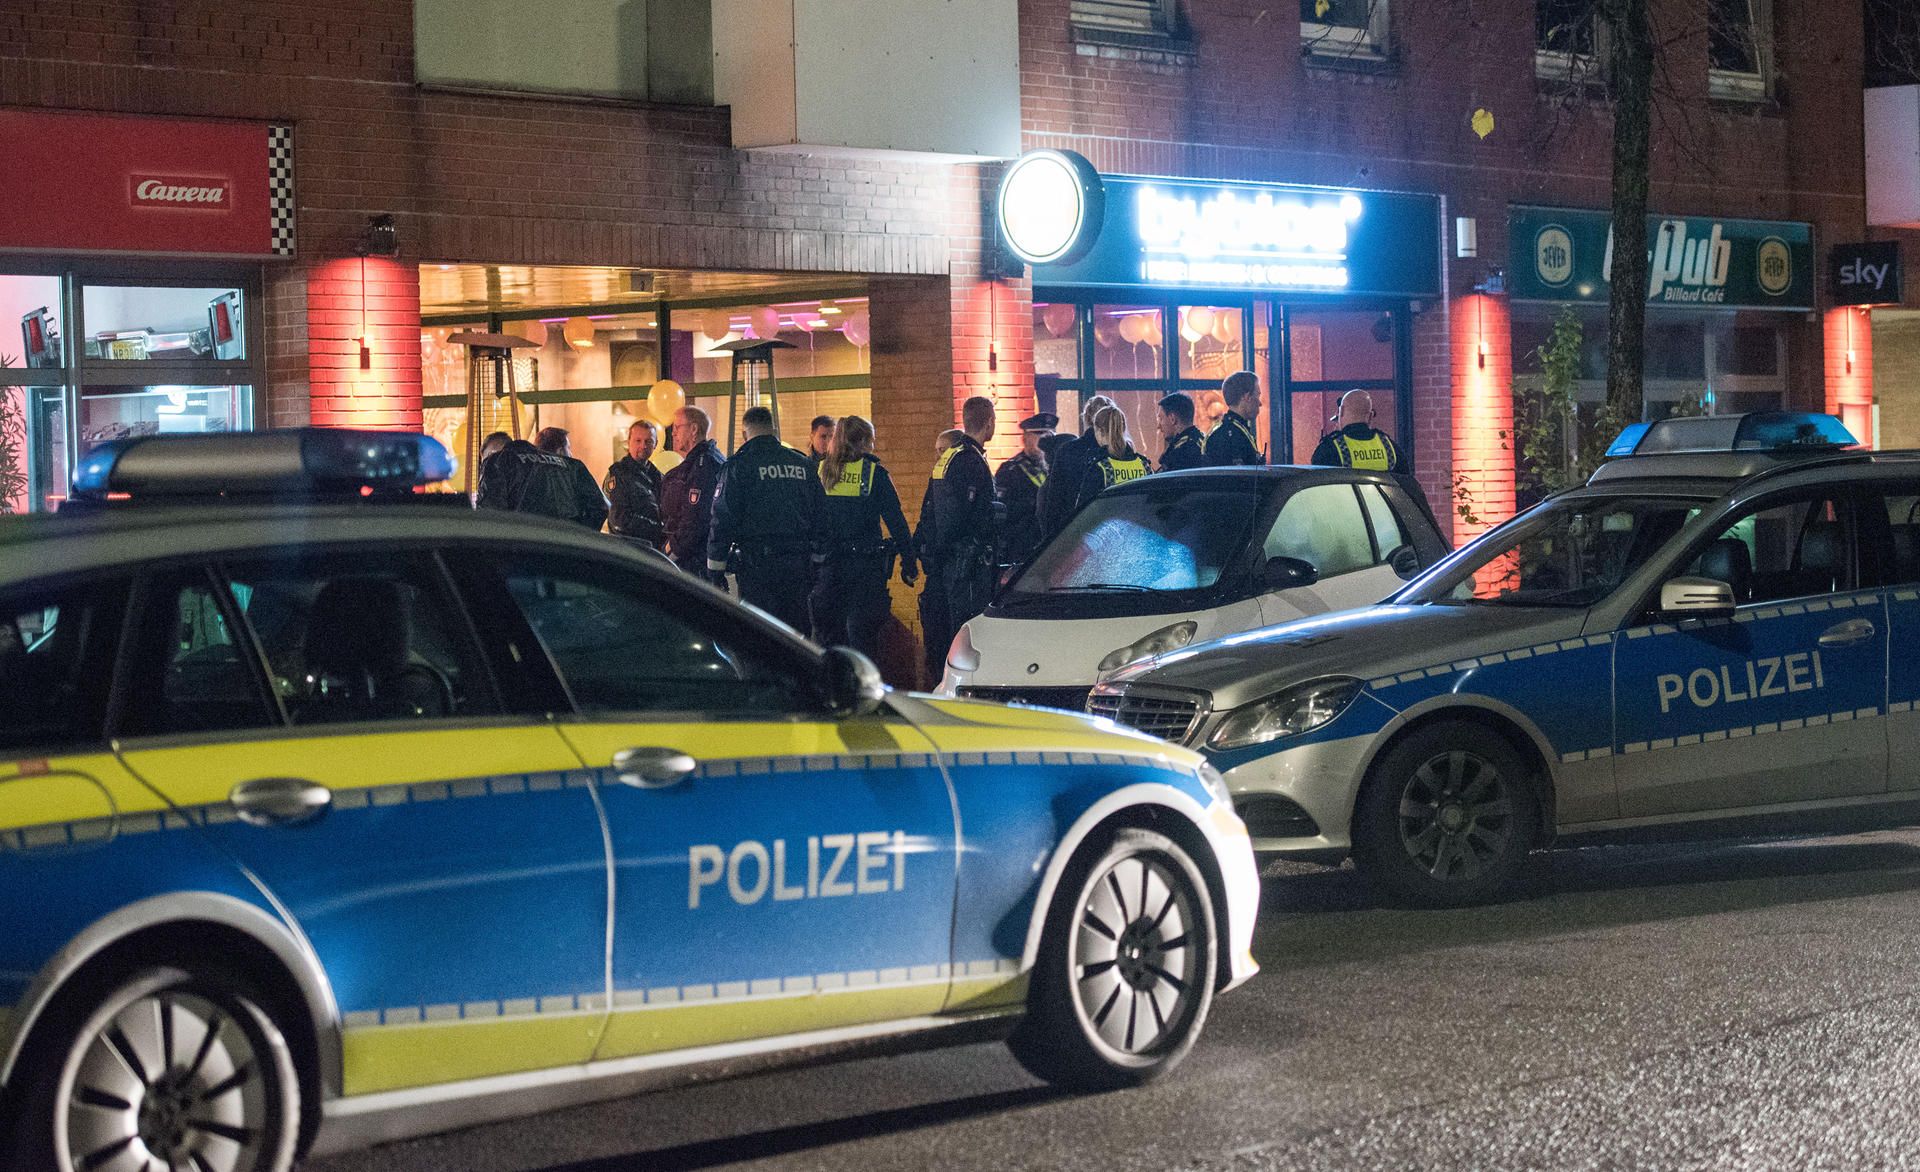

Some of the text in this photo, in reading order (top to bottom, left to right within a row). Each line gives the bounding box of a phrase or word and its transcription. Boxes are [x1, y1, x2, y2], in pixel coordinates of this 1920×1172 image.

[136, 179, 224, 204] Carrera
[1542, 245, 1567, 269] JEVER
[1839, 257, 1889, 290] sky
[1664, 287, 1725, 303] Billard Café
[517, 452, 568, 468] POLIZEI
[1353, 448, 1386, 462] POLIZEI
[758, 463, 807, 481] POLIZEI
[1656, 650, 1824, 713] POLIZEI
[688, 829, 906, 910] POLIZEI
